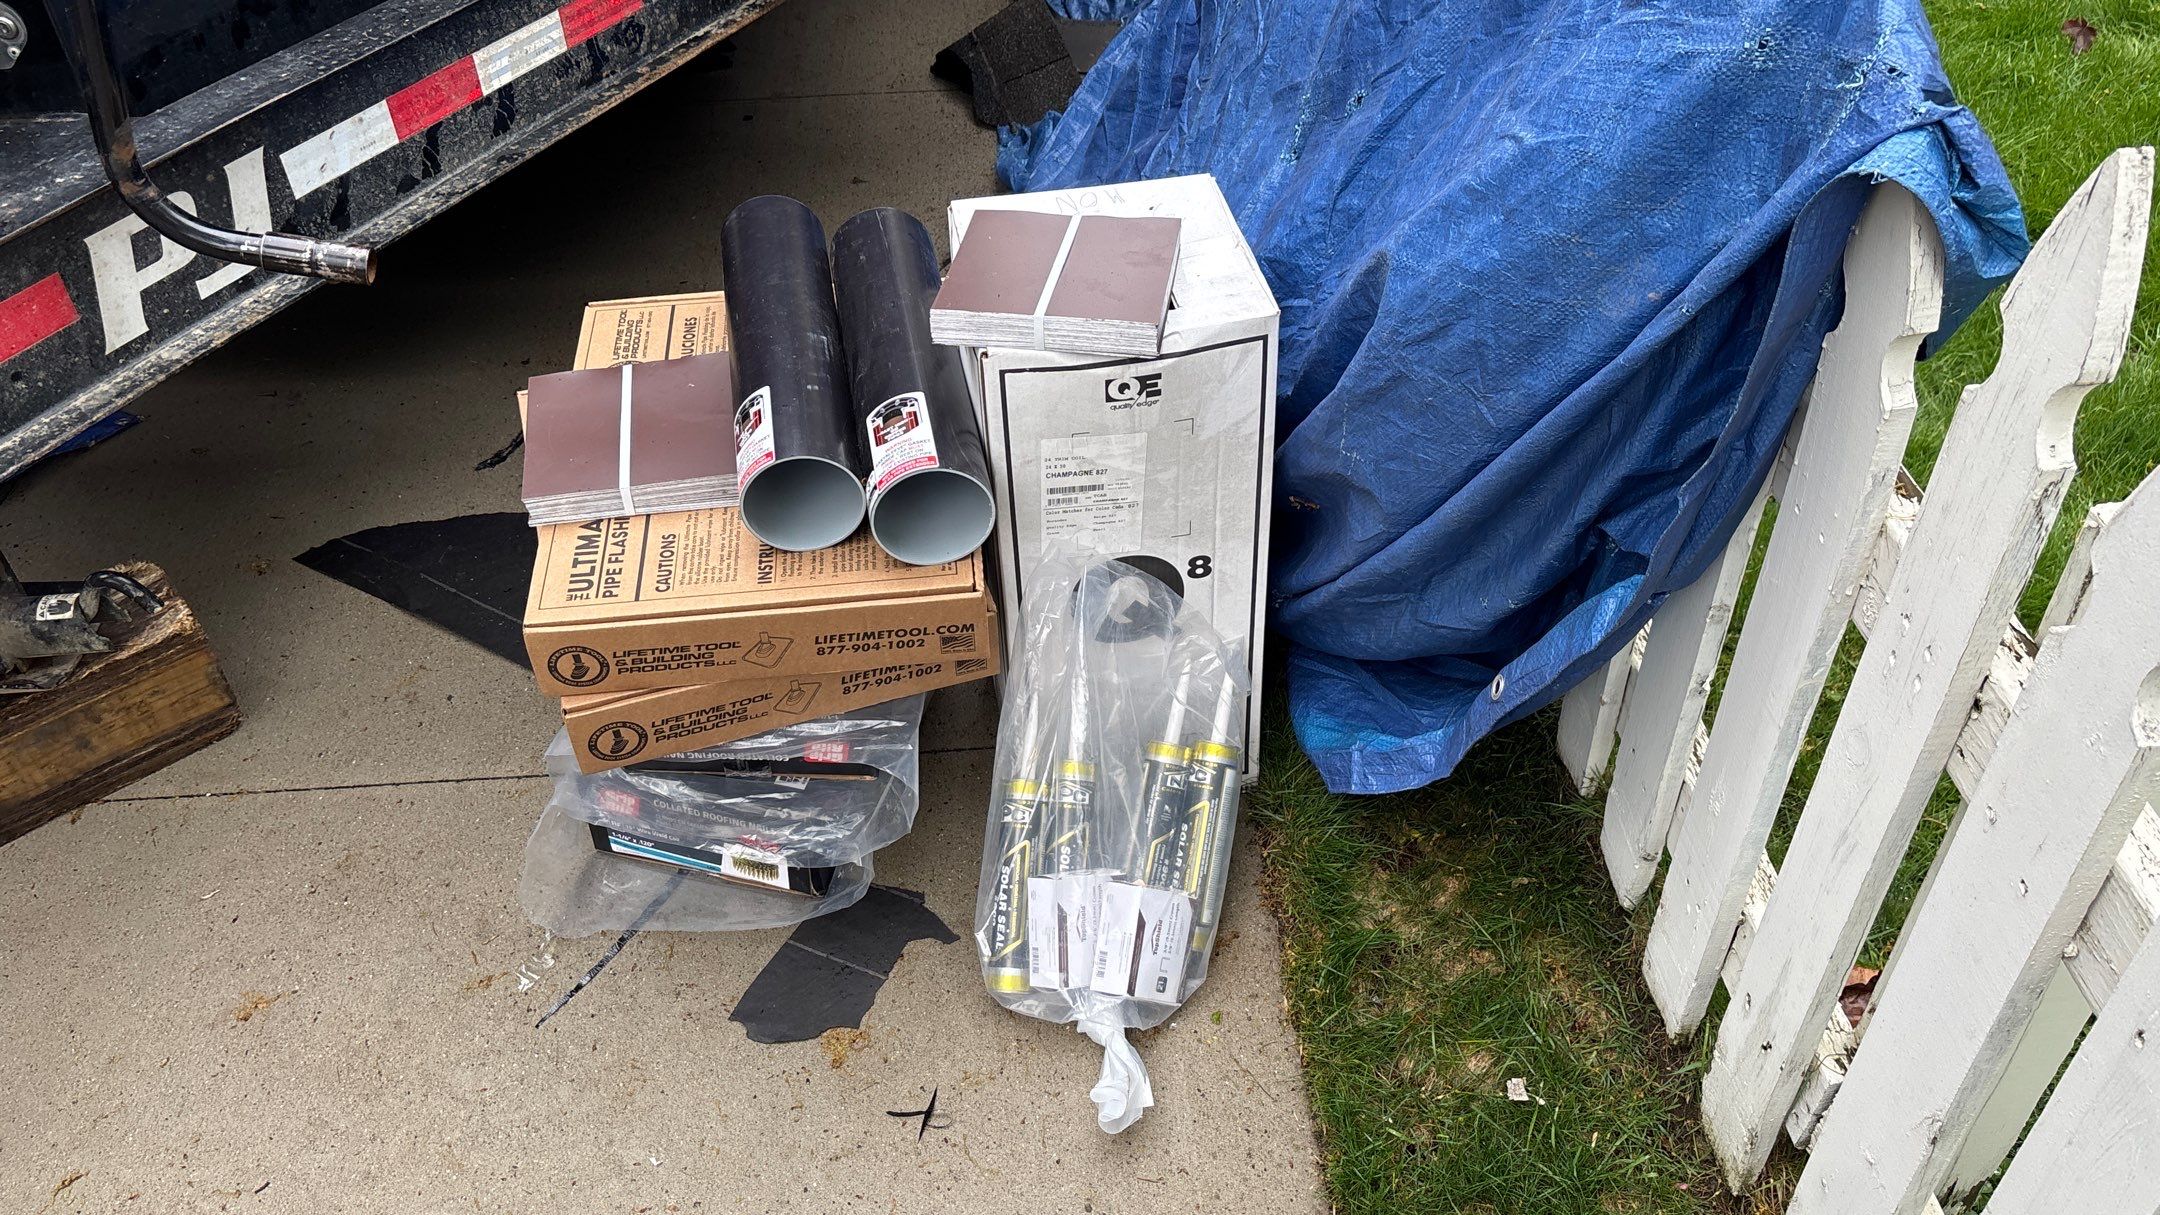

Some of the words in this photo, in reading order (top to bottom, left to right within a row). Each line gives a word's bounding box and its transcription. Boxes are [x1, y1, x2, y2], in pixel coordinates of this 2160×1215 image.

[84, 146, 272, 355] PJ
[612, 329, 625, 360] LIFETIME
[623, 320, 635, 353] BUILDING
[631, 320, 643, 358] PRODUCTS
[1110, 401, 1132, 410] quality
[1136, 398, 1159, 408] edge
[1045, 470, 1094, 479] CHAMPAGNE
[655, 533, 676, 592] CAUTIONS
[1187, 555, 1213, 579] 8
[566, 592, 591, 601] THE
[602, 567, 623, 598] PIPE
[815, 623, 975, 645] LIFETIMETOOL.COM
[816, 638, 926, 656] 877-904-1002
[612, 644, 691, 659] LIFETIME
[615, 658, 629, 667] &
[631, 652, 715, 666] BUILDING
[617, 659, 715, 675] PRODUCTS
[842, 664, 942, 695] 877-904-1002
[651, 704, 726, 729] LIFETIME
[653, 727, 666, 736] &
[668, 706, 748, 733] BUILDING
[655, 714, 749, 743] PRODUCTS
[749, 711, 769, 719] LLC
[809, 752, 843, 763] Grip
[653, 799, 700, 817] COLLATED
[702, 811, 747, 827] ROOFING
[1175, 822, 1188, 867] SOLAR
[998, 865, 1010, 911] SOLAR
[995, 912, 1007, 951] SEAL
[1153, 919, 1163, 956] TopShield
